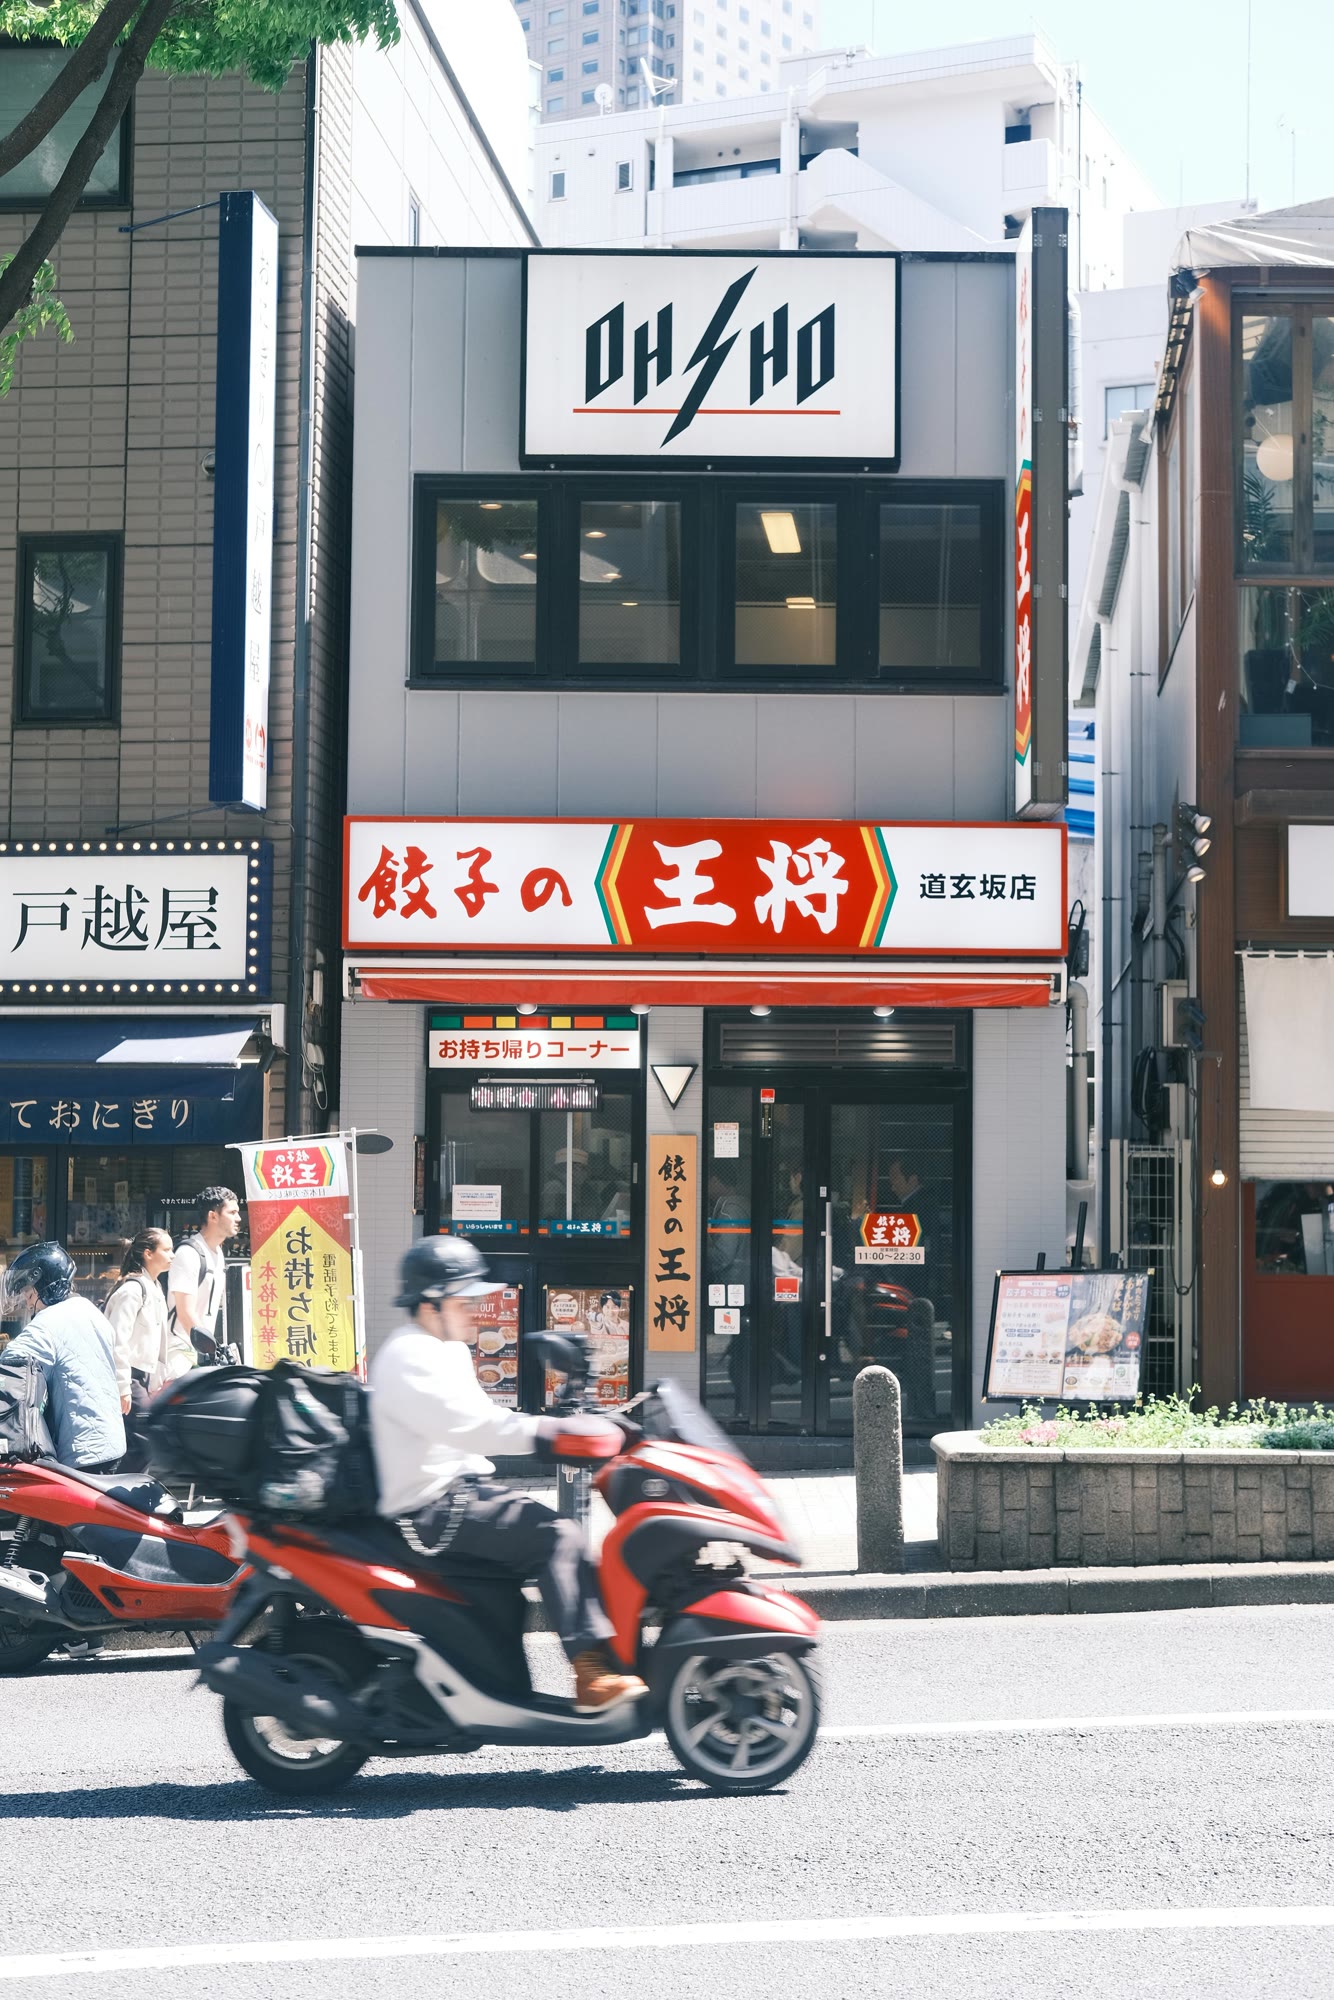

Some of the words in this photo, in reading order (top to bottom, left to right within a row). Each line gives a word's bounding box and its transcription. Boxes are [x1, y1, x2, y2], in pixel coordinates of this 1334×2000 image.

[919, 873, 1036, 900] 道玄坂店
[11, 884, 222, 953] 戸越屋
[438, 1039, 630, 1060] お持ち帰りコーナー
[877, 1215, 905, 1227] 餃子の
[653, 1155, 691, 1332] 餃子の王将
[870, 1226, 911, 1246] 王将
